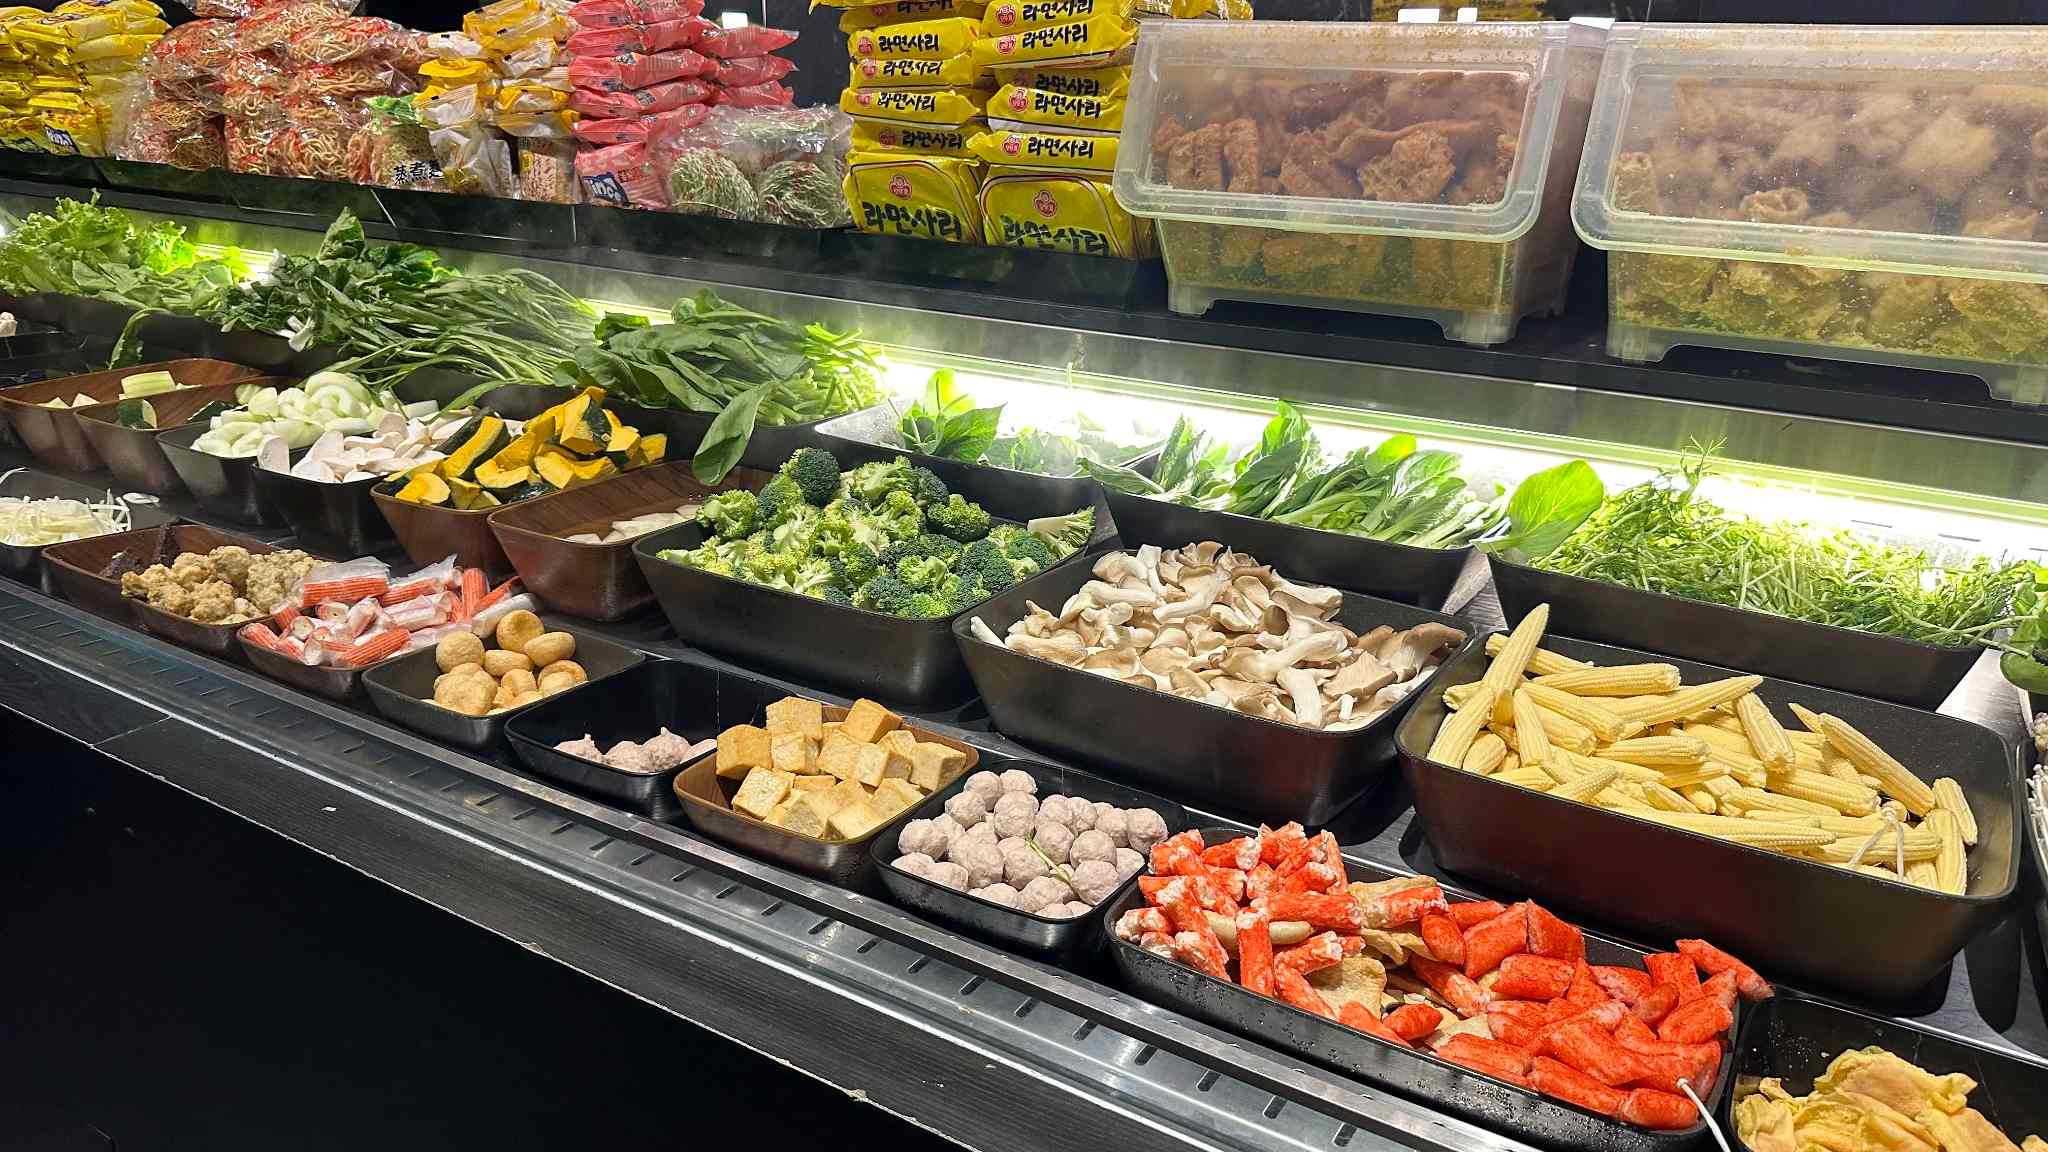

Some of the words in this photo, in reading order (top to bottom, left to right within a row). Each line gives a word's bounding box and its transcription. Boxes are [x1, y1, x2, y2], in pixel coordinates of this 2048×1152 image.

[1022, 0, 1093, 21] 라면사리
[878, 34, 939, 53] 라면사리
[1022, 24, 1088, 48] 라면사리
[883, 60, 943, 76] 라면사리
[1036, 74, 1099, 96] 라면사리
[877, 92, 936, 112] 라면사리
[1035, 93, 1101, 119] 라면사리
[901, 129, 962, 149] 라면사리
[1028, 137, 1094, 158] 라면사리
[861, 201, 961, 240] 라면사리
[1000, 214, 1110, 256] 라면사리
